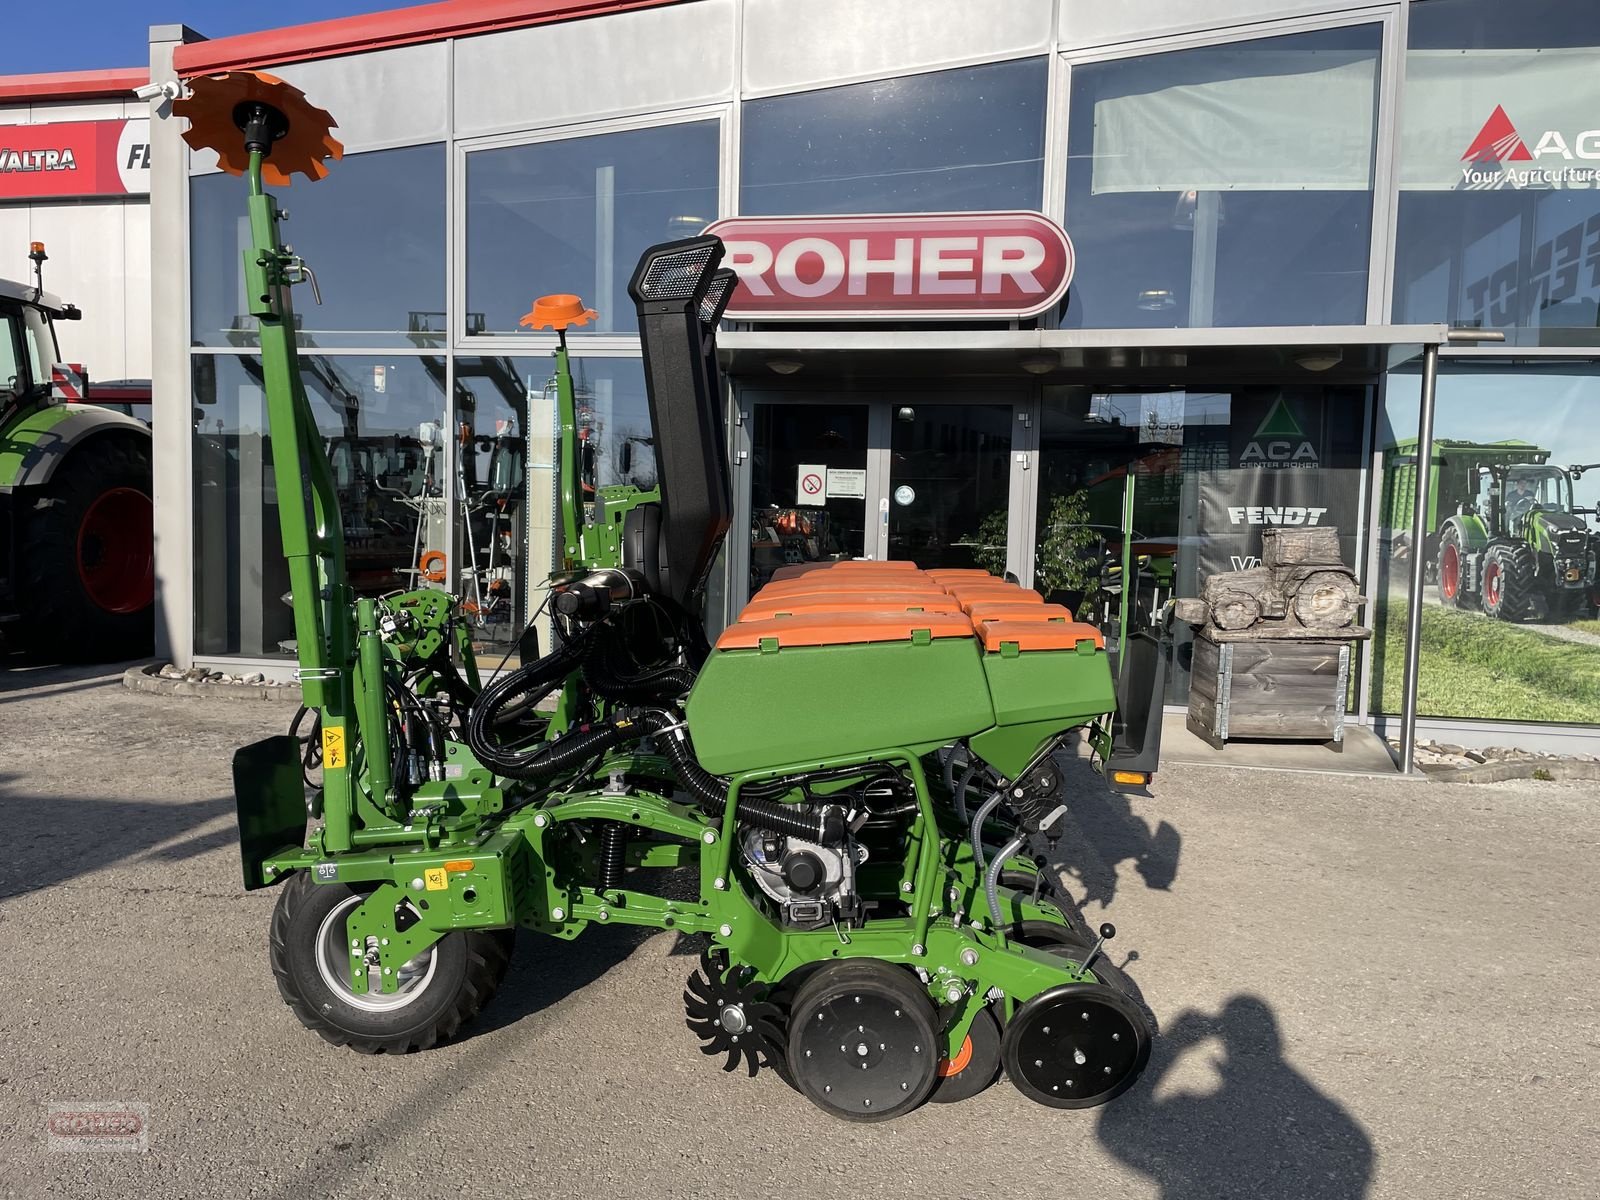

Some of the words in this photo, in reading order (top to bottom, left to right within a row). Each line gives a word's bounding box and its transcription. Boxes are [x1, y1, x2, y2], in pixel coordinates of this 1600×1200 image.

[1462, 168, 1501, 183] Your
[722, 235, 1046, 298] ROHER
[1239, 441, 1319, 461] ACA
[1227, 506, 1327, 525] FENDT
